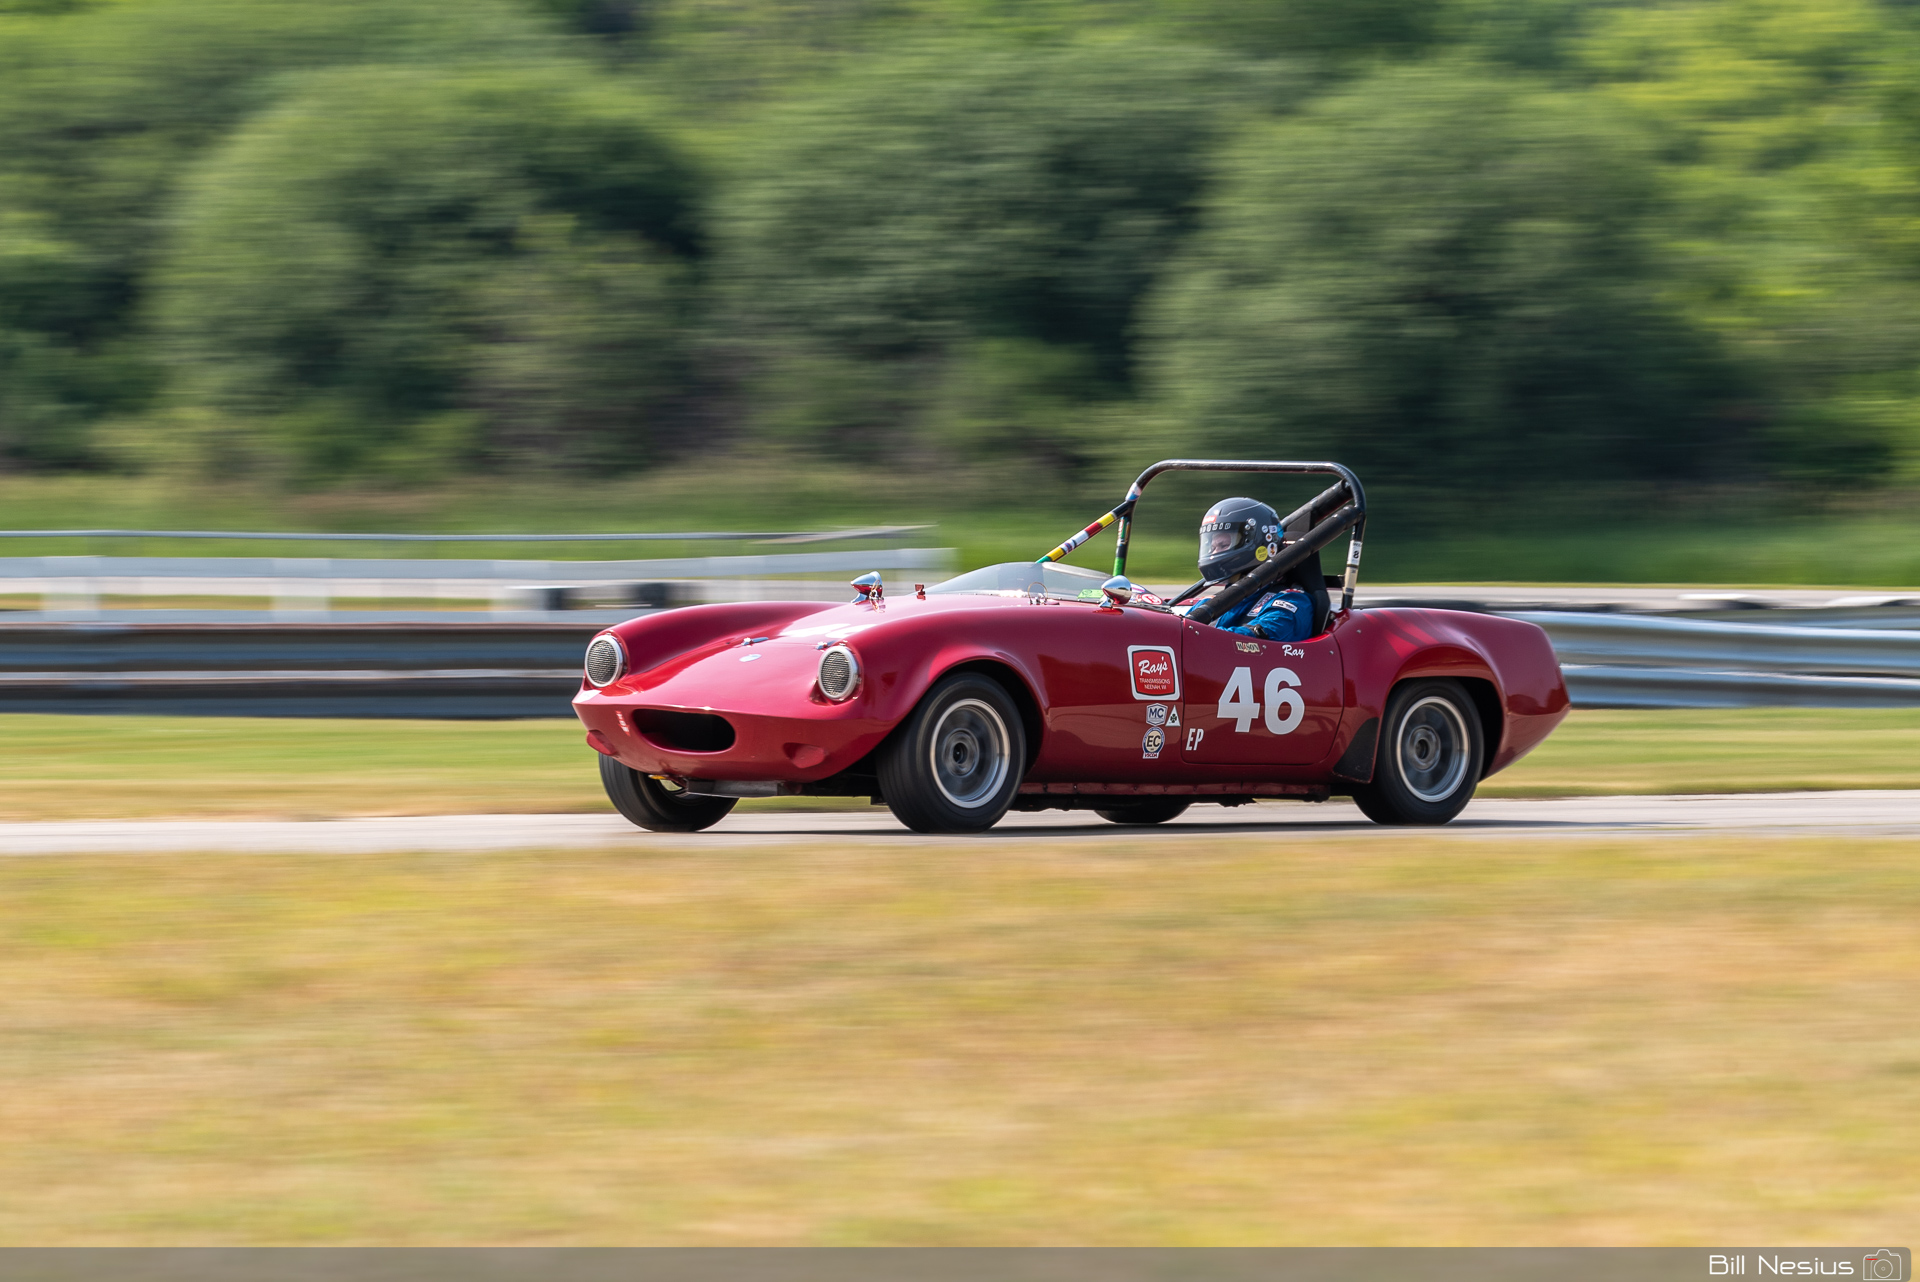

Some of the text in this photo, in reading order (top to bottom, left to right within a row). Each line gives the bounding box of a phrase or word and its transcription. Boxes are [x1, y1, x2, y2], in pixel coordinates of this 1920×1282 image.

[1282, 644, 1305, 659] Ray
[1138, 656, 1168, 676] Ray's
[1139, 677, 1170, 685] TRANSMISSIONS
[1217, 667, 1305, 735] 46
[1149, 708, 1164, 718] MC
[1147, 735, 1161, 747] EC
[1186, 728, 1204, 751] EP
